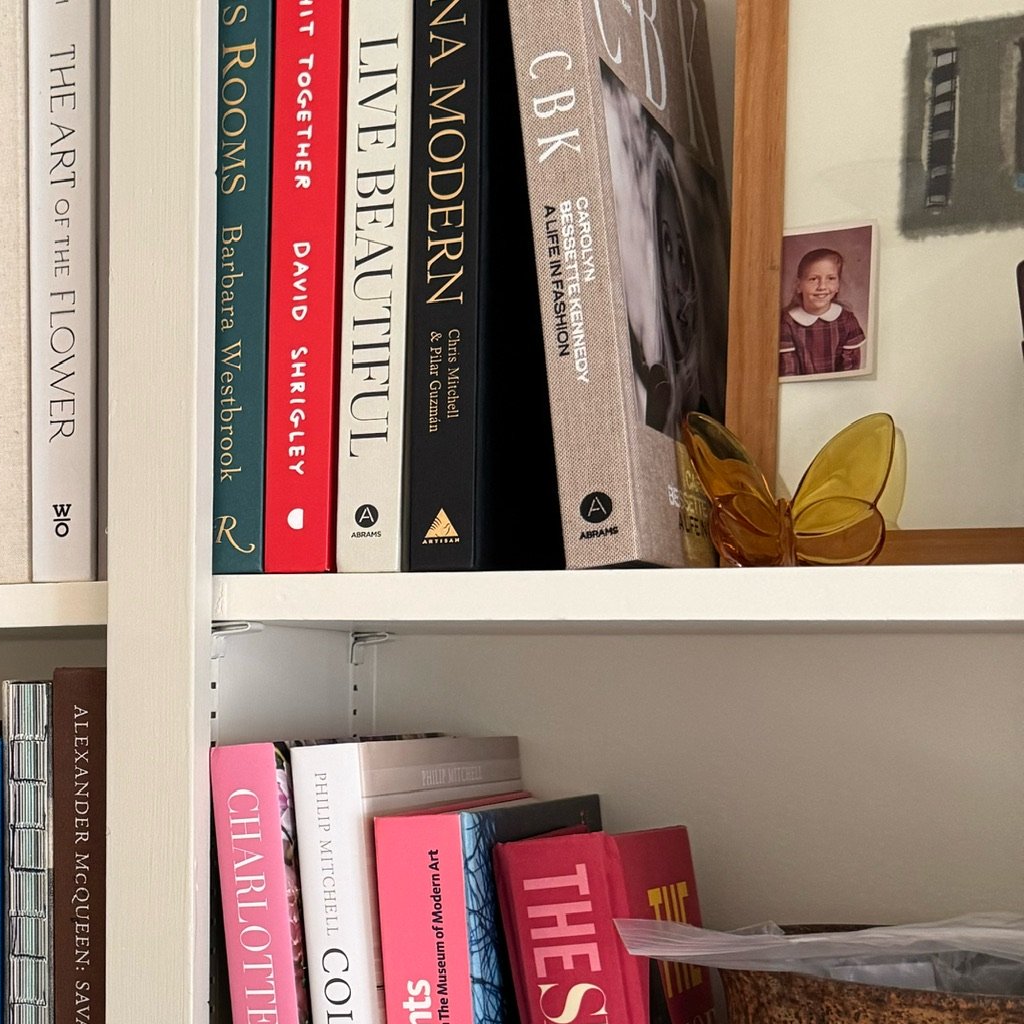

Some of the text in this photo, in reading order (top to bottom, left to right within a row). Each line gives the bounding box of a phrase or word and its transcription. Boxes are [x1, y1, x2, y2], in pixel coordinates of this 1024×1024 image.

[293, 53, 315, 190] TOGETHER
[426, 80, 467, 305] MODERN
[575, 196, 597, 282] CAROLYN
[49, 44, 76, 443] THE ART OF THE FLOWER
[349, 33, 400, 459] LIVE BEAUTIFUL
[544, 205, 571, 357] A LIFE IN FASHION
[559, 199, 590, 384] BESSETTE KENNEDY
[219, 224, 244, 483] Barbara Westbrook
[287, 241, 312, 476] DAVID SHRIGLEY
[429, 345, 443, 434] Pilar Guzmán
[447, 328, 461, 420] Chris Mitchell
[351, 530, 382, 539] ABRAMS
[579, 526, 619, 541] ABRAMS
[73, 704, 90, 844] ALEXANDER
[314, 771, 331, 833] PHILIP
[318, 839, 341, 937] MITCHELL
[428, 848, 440, 871] Art
[429, 873, 444, 924] Modern
[432, 925, 444, 940] of
[522, 863, 602, 978] THE
[435, 941, 449, 996] Museum
[437, 996, 451, 1021] The
